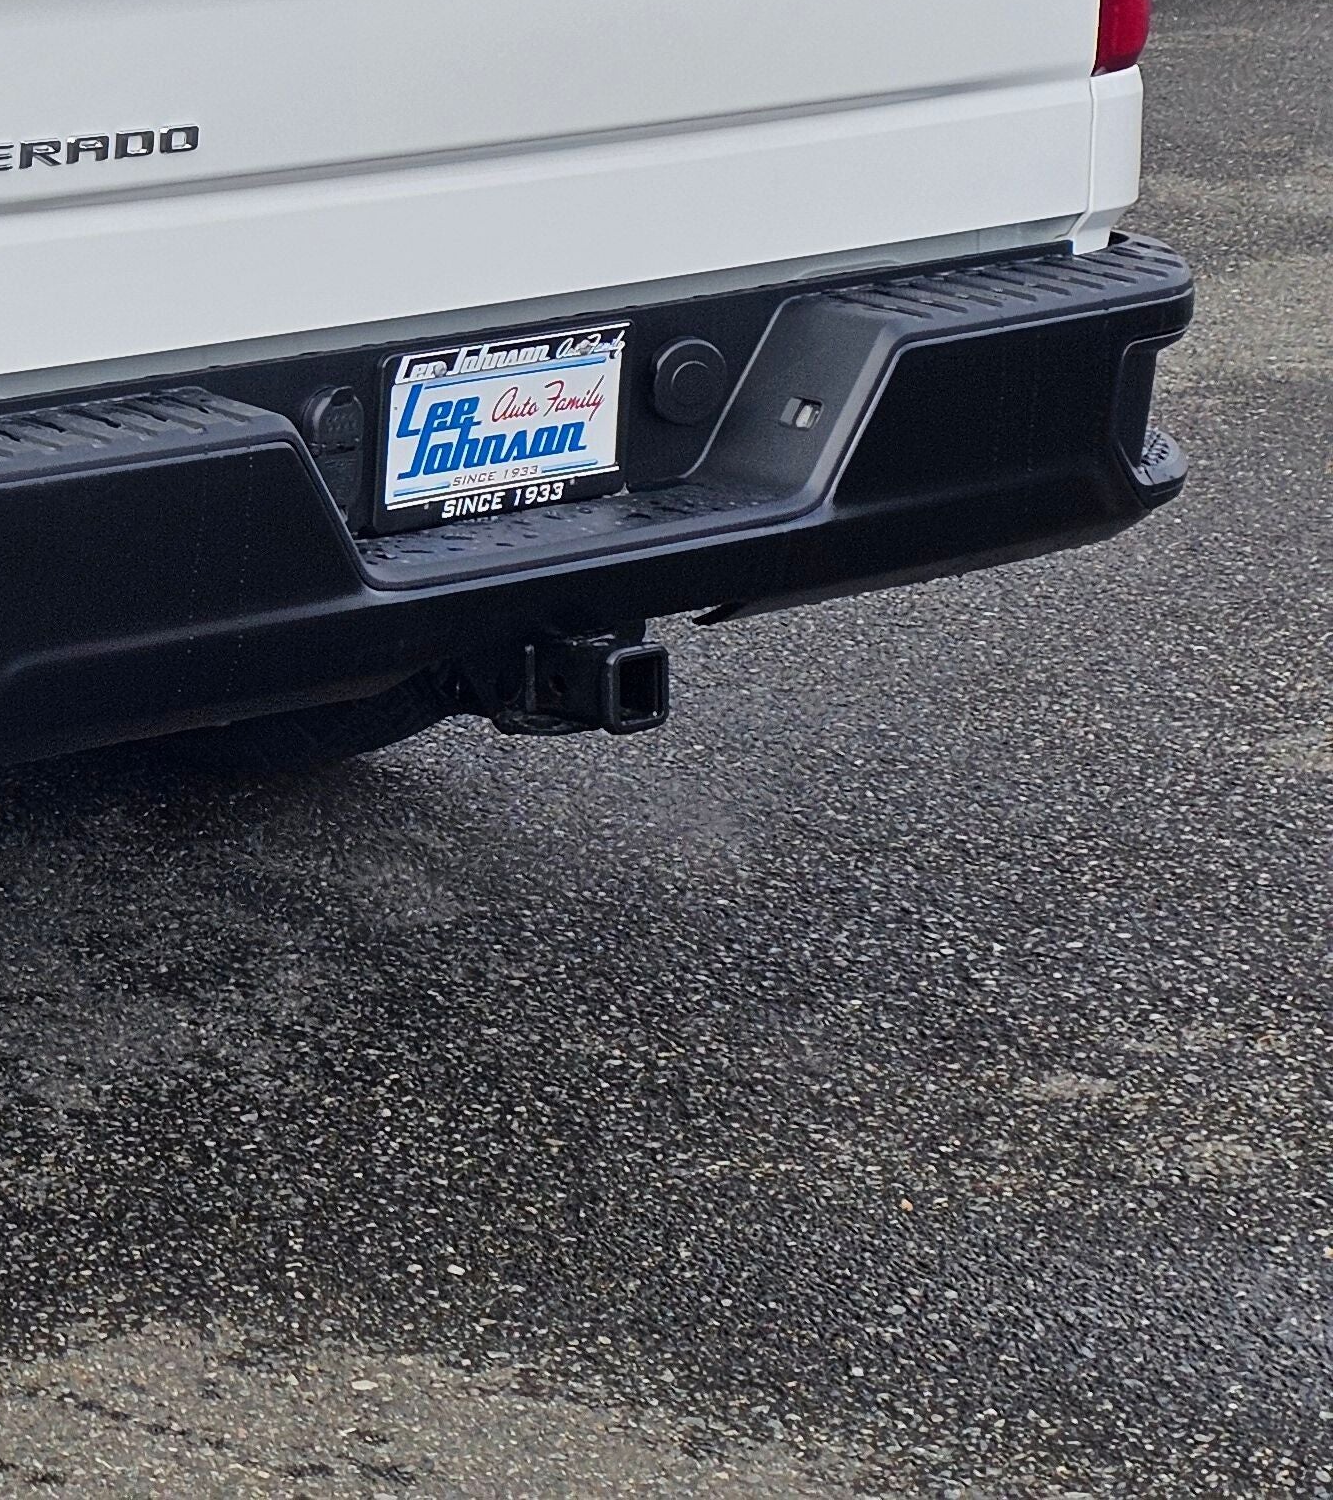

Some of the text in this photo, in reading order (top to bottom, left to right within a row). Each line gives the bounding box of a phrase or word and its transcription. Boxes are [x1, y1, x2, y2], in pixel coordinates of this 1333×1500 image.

[447, 344, 551, 376] Johnson
[396, 383, 483, 438] Lee
[491, 375, 606, 423] Auto Family
[396, 420, 588, 481] Johnson
[452, 464, 540, 487] SINCE 1933
[441, 481, 566, 519] SINCE 1933
